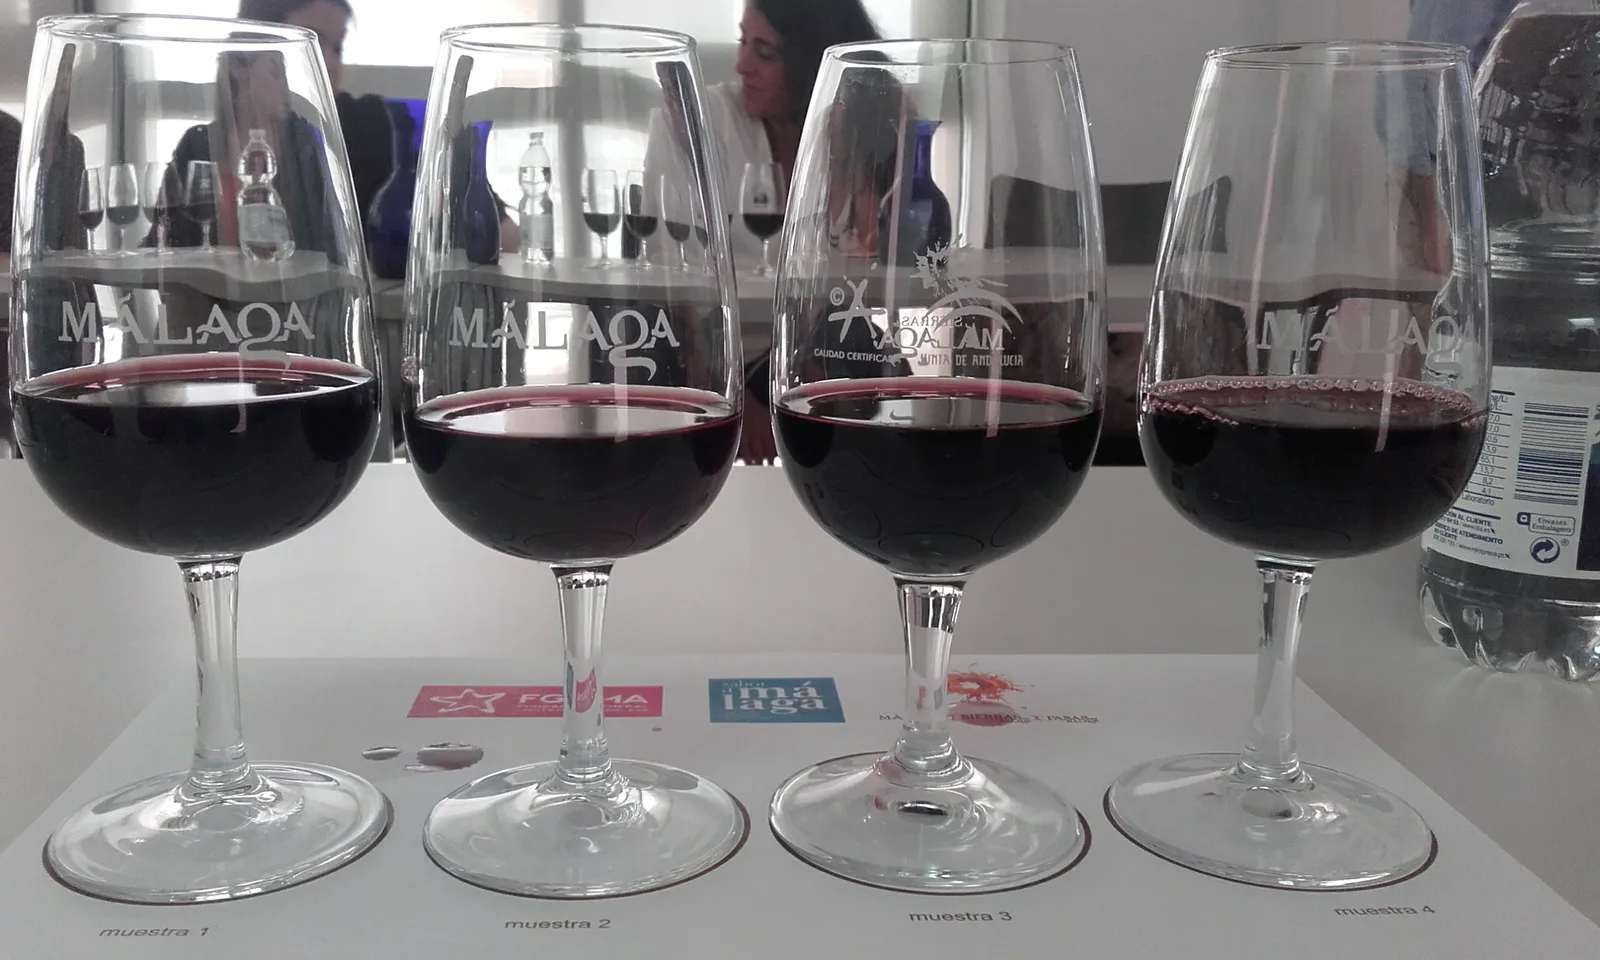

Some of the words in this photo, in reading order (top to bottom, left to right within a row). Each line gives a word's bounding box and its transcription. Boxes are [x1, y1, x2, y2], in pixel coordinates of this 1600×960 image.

[955, 355, 967, 366] DE
[972, 355, 1024, 366] ANDLUCIA
[1538, 517, 1567, 526] Envases
[1334, 905, 1418, 916] muestra
[1422, 905, 1436, 914] 4
[909, 912, 993, 921] muestra
[998, 911, 1012, 921] 3
[504, 919, 591, 929] muestra
[598, 919, 611, 929] 2
[99, 927, 189, 937] muestra
[200, 927, 210, 937] 1
